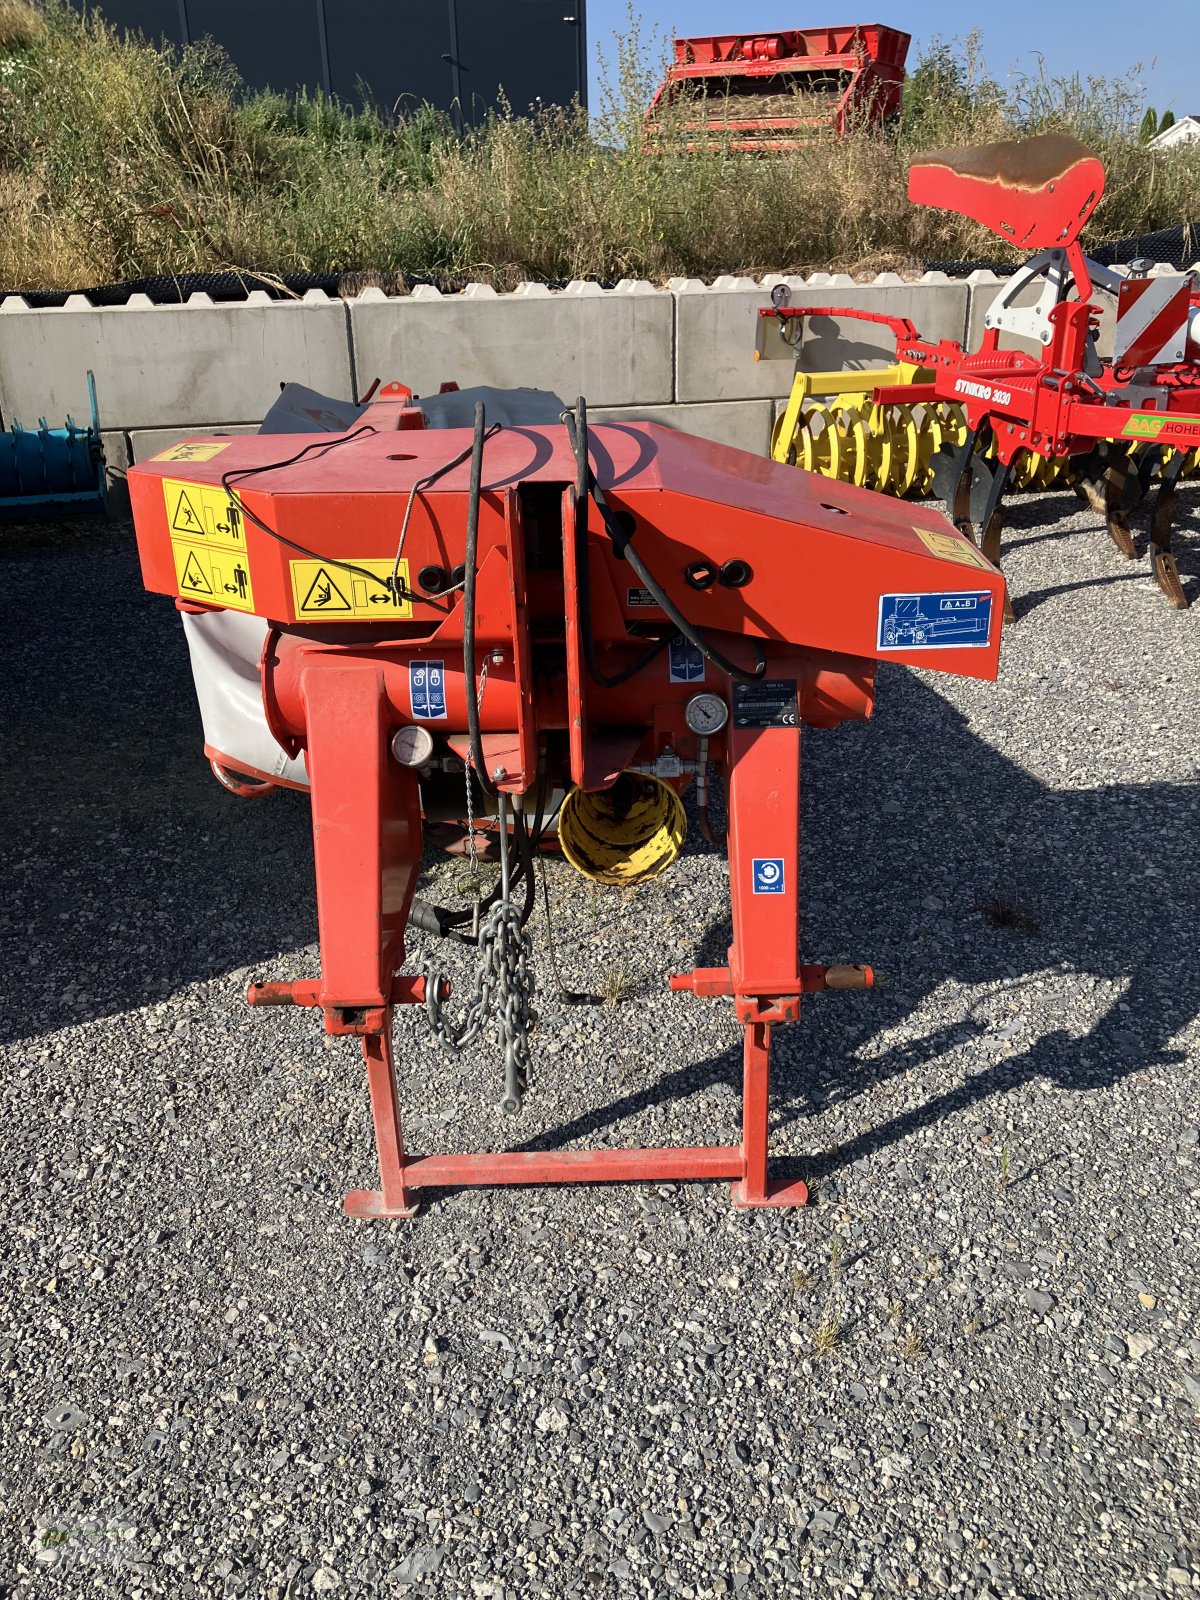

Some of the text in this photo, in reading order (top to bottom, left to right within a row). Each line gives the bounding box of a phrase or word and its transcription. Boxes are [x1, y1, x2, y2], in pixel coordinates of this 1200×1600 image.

[954, 378, 1011, 405] SYNKRO 3030
[1128, 418, 1200, 436] BAG HOHE
